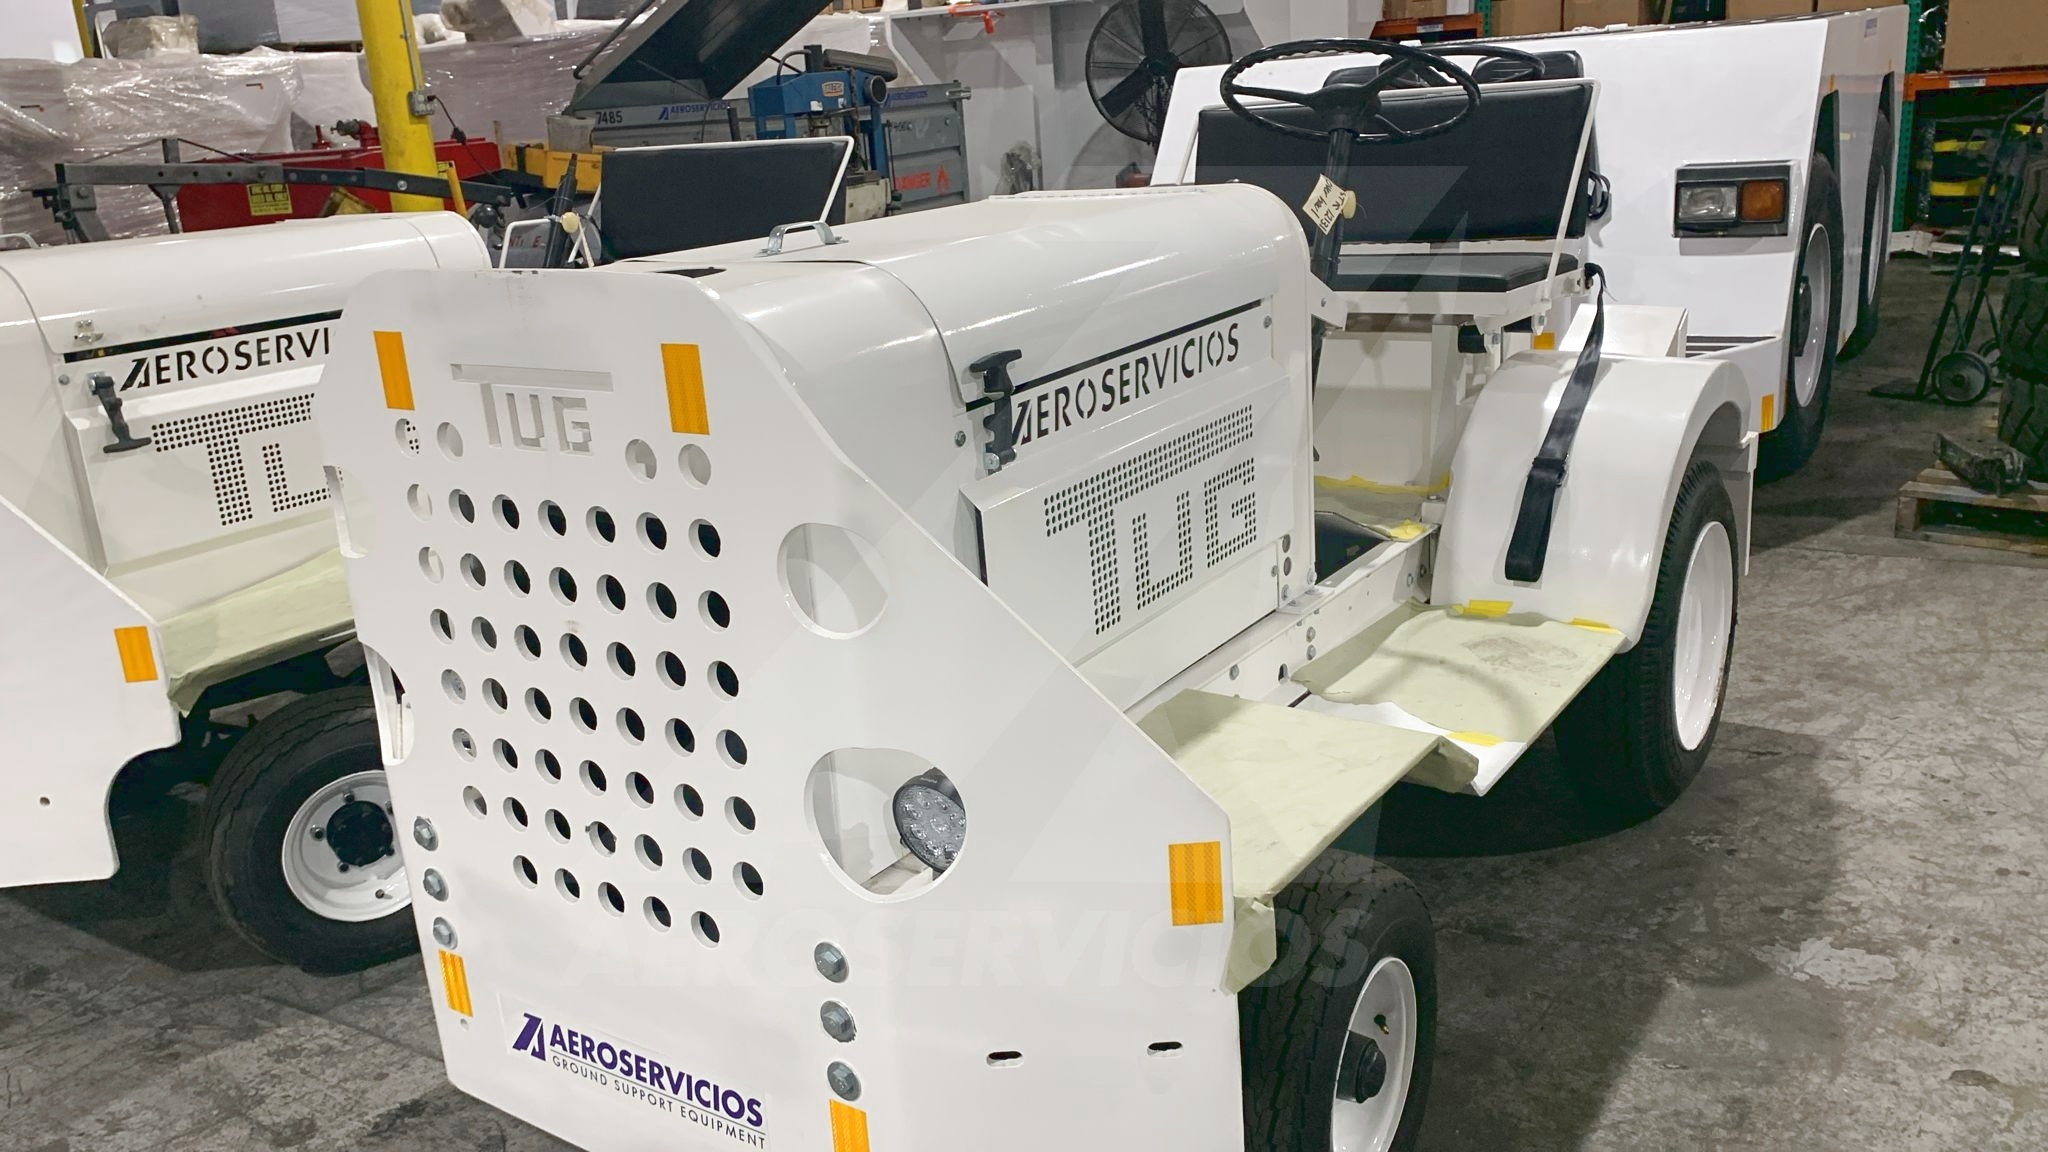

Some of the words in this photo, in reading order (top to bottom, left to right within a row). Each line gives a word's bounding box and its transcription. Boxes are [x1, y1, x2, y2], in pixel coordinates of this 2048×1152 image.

[595, 110, 623, 125] 7485
[450, 364, 614, 454] TUG
[1012, 323, 1239, 446] AEROSERVICIOS
[1044, 404, 1257, 635] TUG
[550, 1024, 763, 1128] AEROSERVICIOS
[552, 1055, 608, 1086] GROUND
[614, 1079, 674, 1113] SUPPORT
[680, 1105, 765, 1150] EQUIPMENT
